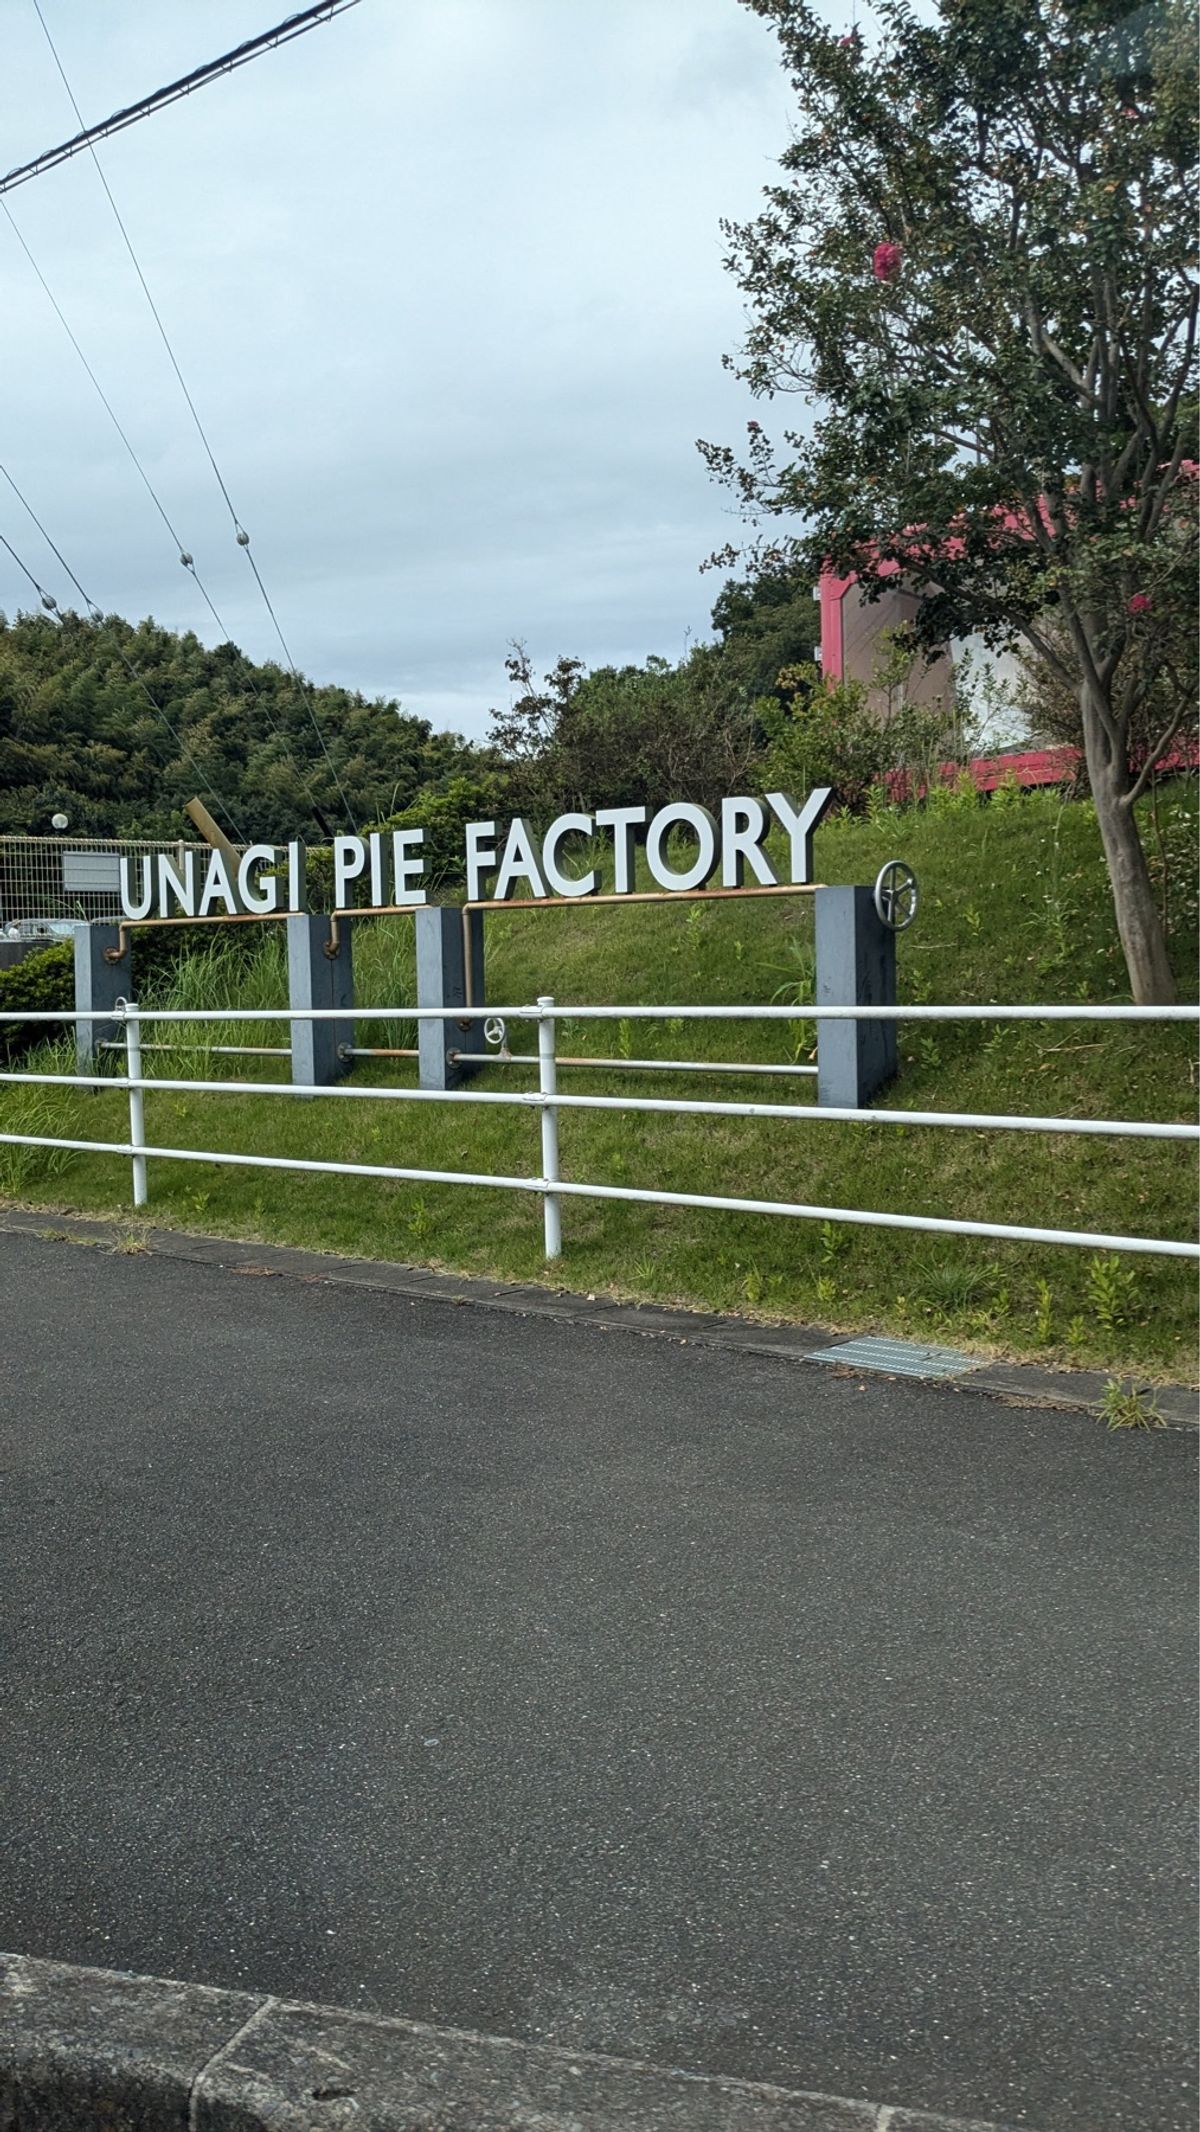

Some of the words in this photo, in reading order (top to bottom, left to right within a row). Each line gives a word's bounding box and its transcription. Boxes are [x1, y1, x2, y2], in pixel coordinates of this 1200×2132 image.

[120, 841, 303, 920] UNAGI
[334, 828, 428, 908] PIE
[465, 787, 832, 901] FACTORY
